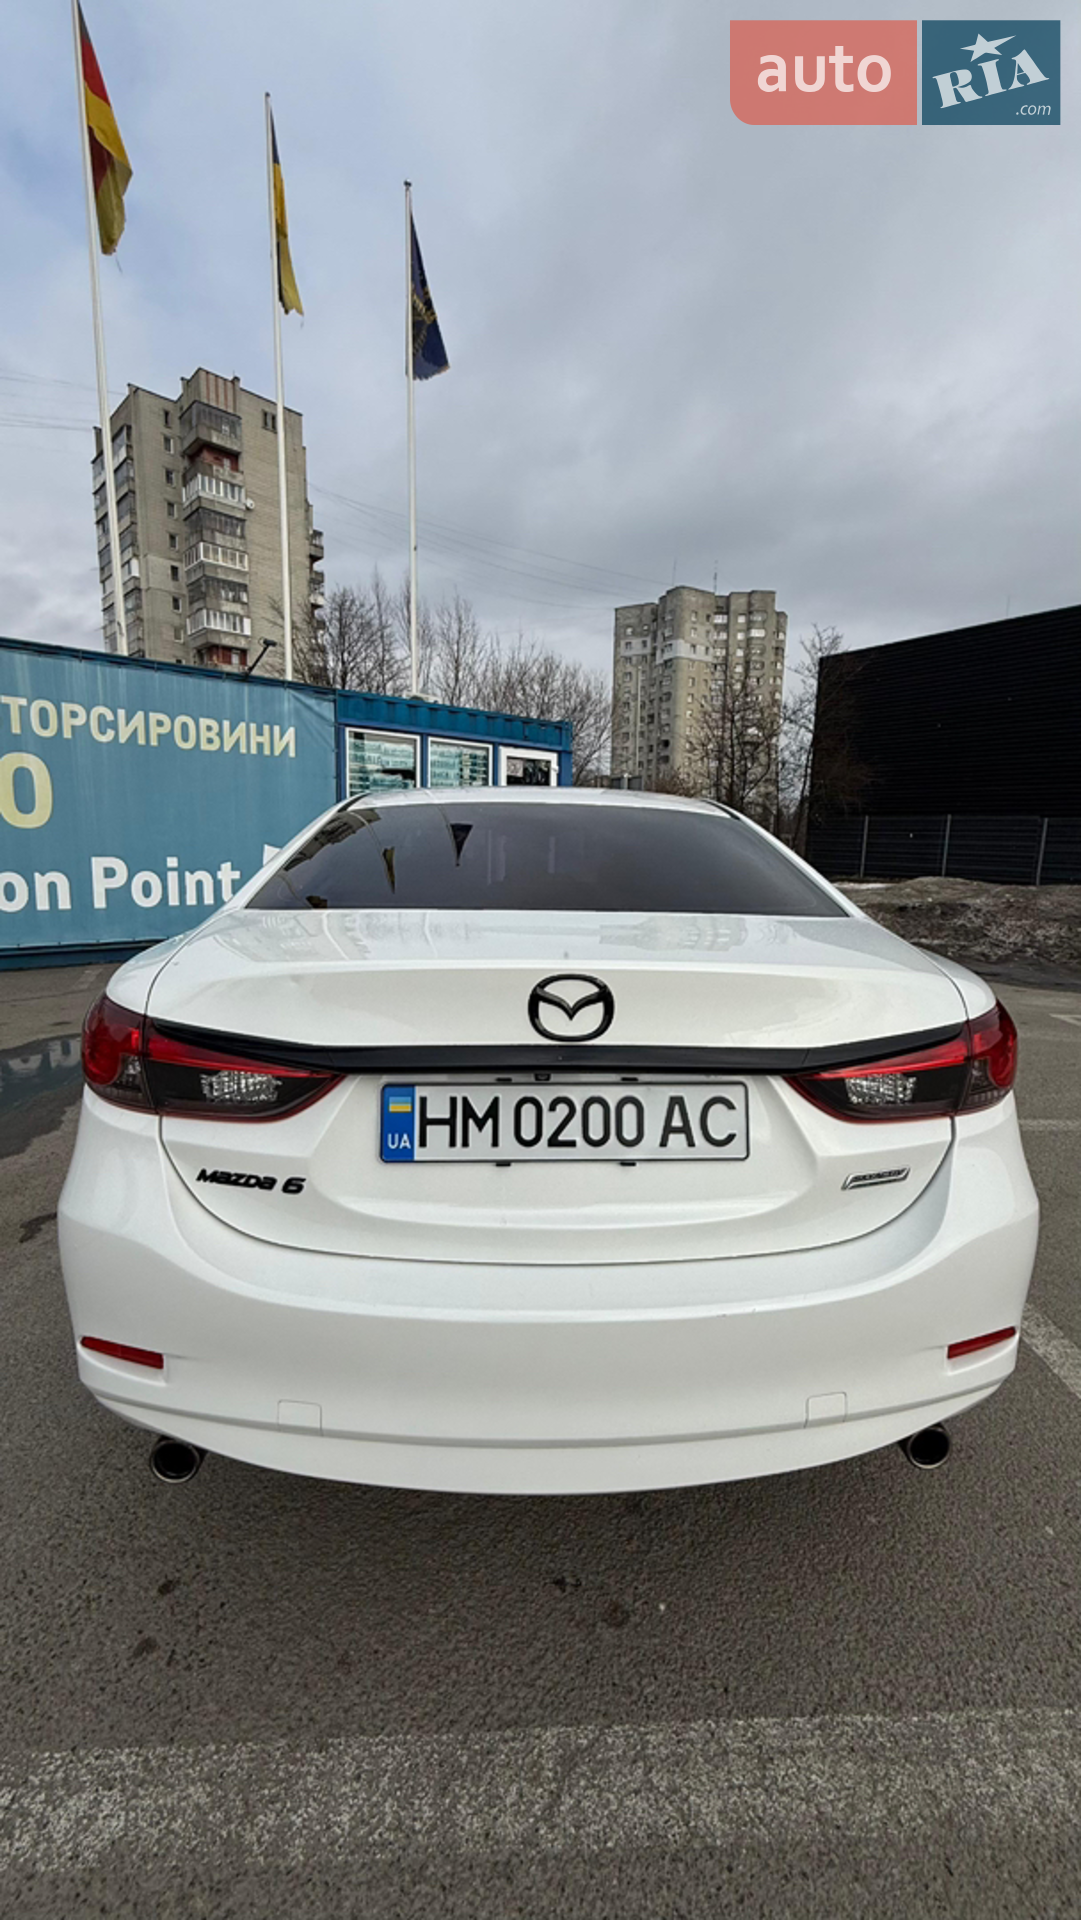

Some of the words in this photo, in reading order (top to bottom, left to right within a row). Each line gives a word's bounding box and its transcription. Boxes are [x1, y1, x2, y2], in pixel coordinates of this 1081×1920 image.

[0, 695, 296, 758] ТОРСИРОВИНИ
[0, 871, 71, 912] on
[91, 856, 241, 909] Point
[387, 1133, 411, 1149] UA
[419, 1096, 500, 1148] HM
[513, 1096, 645, 1148] 0200
[659, 1096, 738, 1148] AC
[281, 1177, 307, 1195] 6
